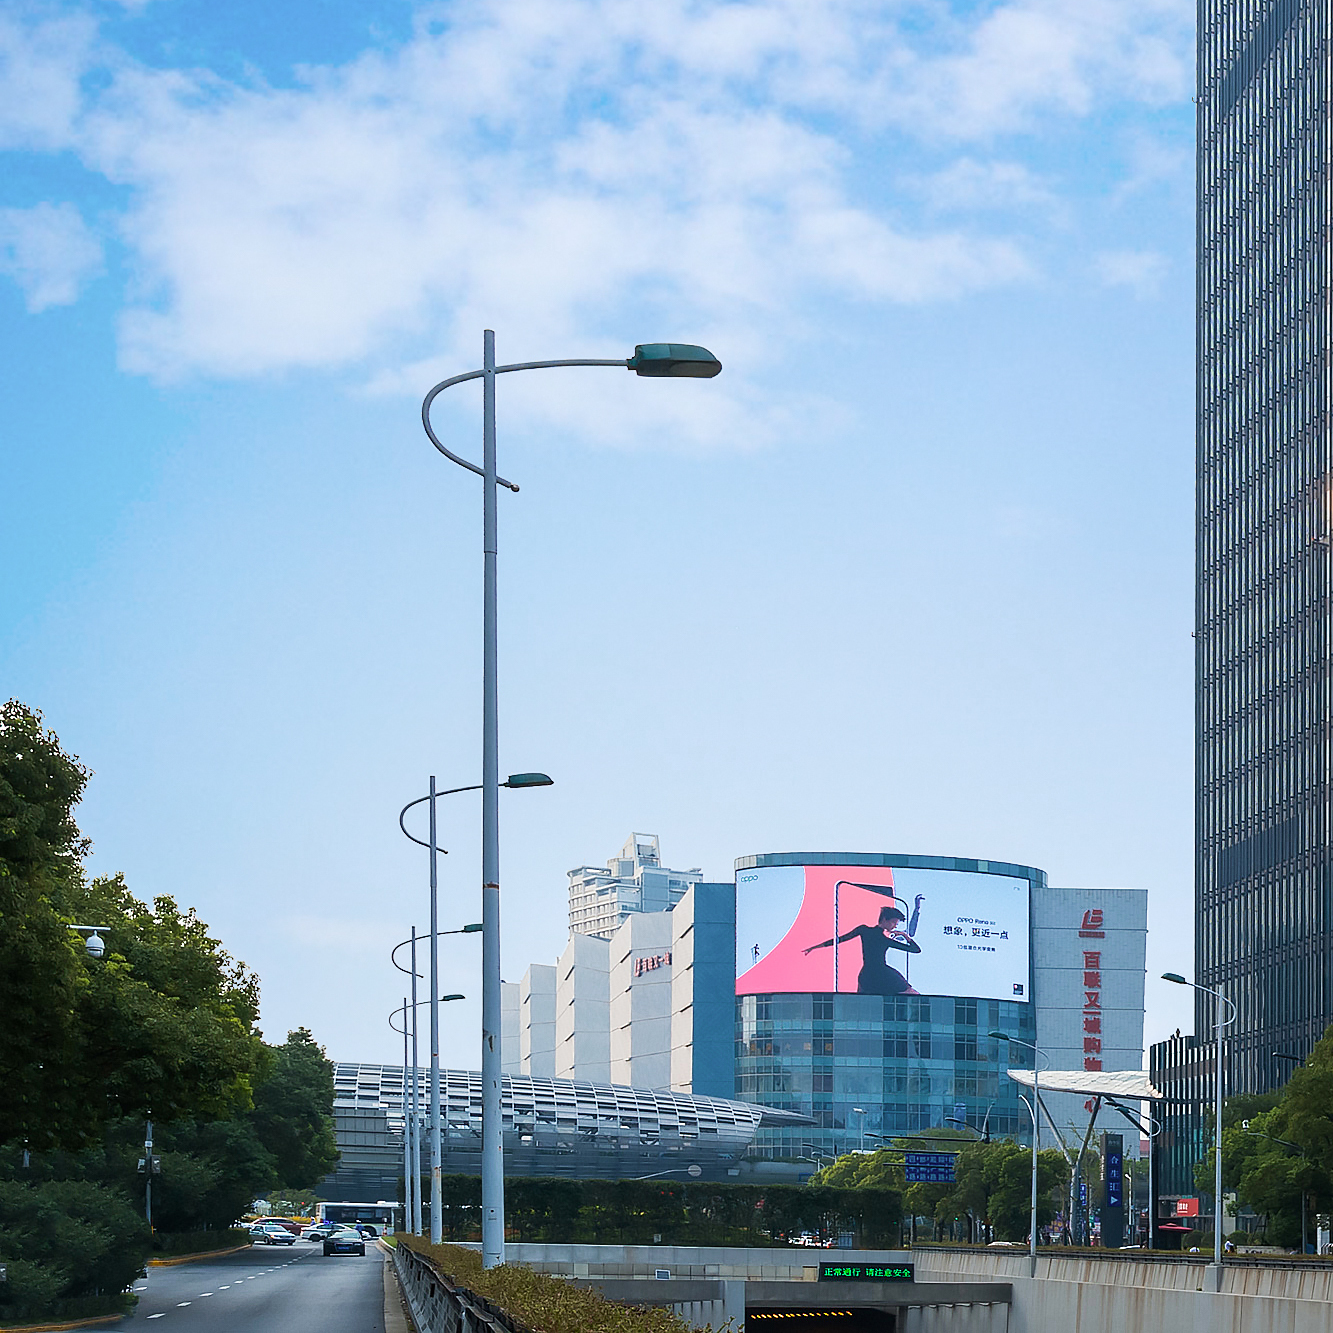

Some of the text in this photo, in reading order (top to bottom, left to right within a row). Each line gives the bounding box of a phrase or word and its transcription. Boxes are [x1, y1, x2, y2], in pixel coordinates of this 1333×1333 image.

[1109, 1155, 1120, 1191] 合生汇
[824, 1267, 911, 1278] 正常通行 请注意安全
